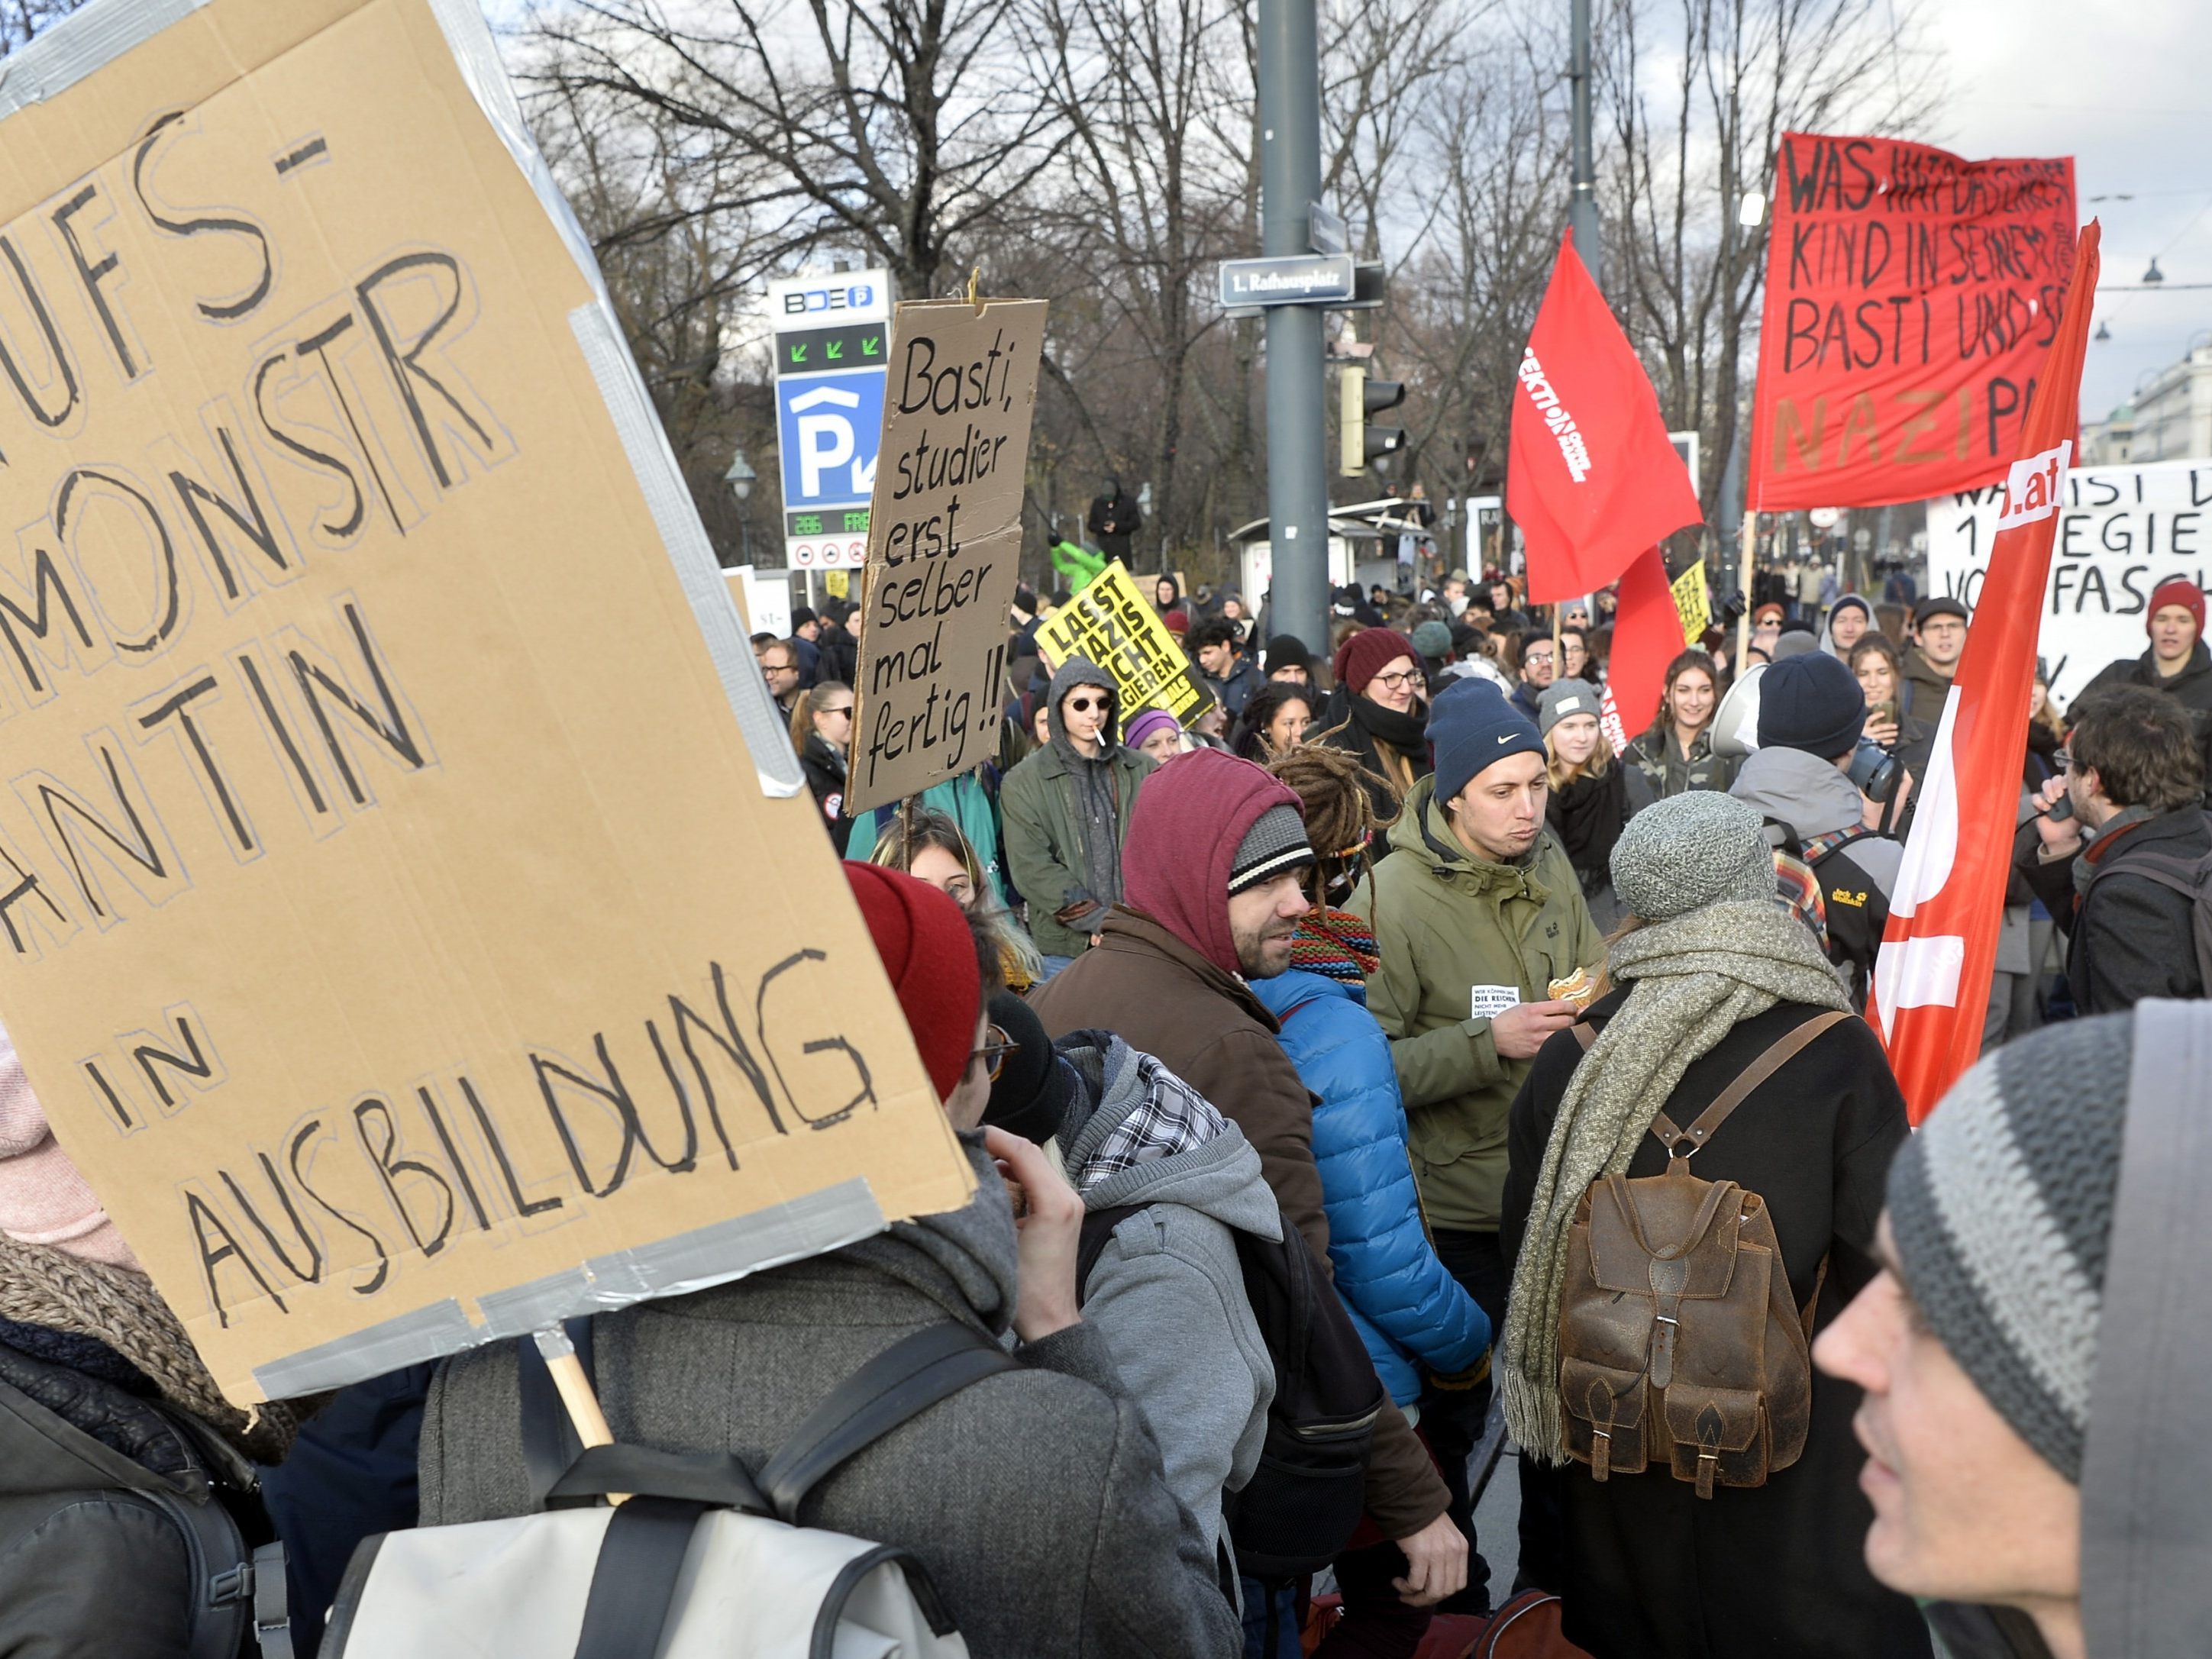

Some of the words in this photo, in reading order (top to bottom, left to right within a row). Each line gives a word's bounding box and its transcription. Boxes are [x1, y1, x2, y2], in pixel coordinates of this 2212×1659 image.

[1784, 139, 1875, 214] WAS
[1248, 269, 1341, 294] Rathausplatz
[1789, 220, 1891, 290] KIND
[1904, 221, 1938, 289] IN
[1957, 290, 2032, 360] UND
[897, 328, 1016, 416] Basti,
[1518, 347, 1577, 436] EKTION
[893, 423, 1008, 500] studier
[1773, 387, 1972, 473] NAZI
[1988, 376, 2036, 457] P
[0, 252, 493, 692] MONSTR
[2000, 457, 2059, 519] .at
[883, 494, 961, 568] erst
[879, 560, 993, 629] selber
[1048, 573, 1125, 653] LASST
[872, 620, 943, 696] mal
[1121, 654, 1177, 712] GIEREN
[84, 1017, 212, 1128] IN
[186, 948, 877, 1328] AUSBILDUNG
